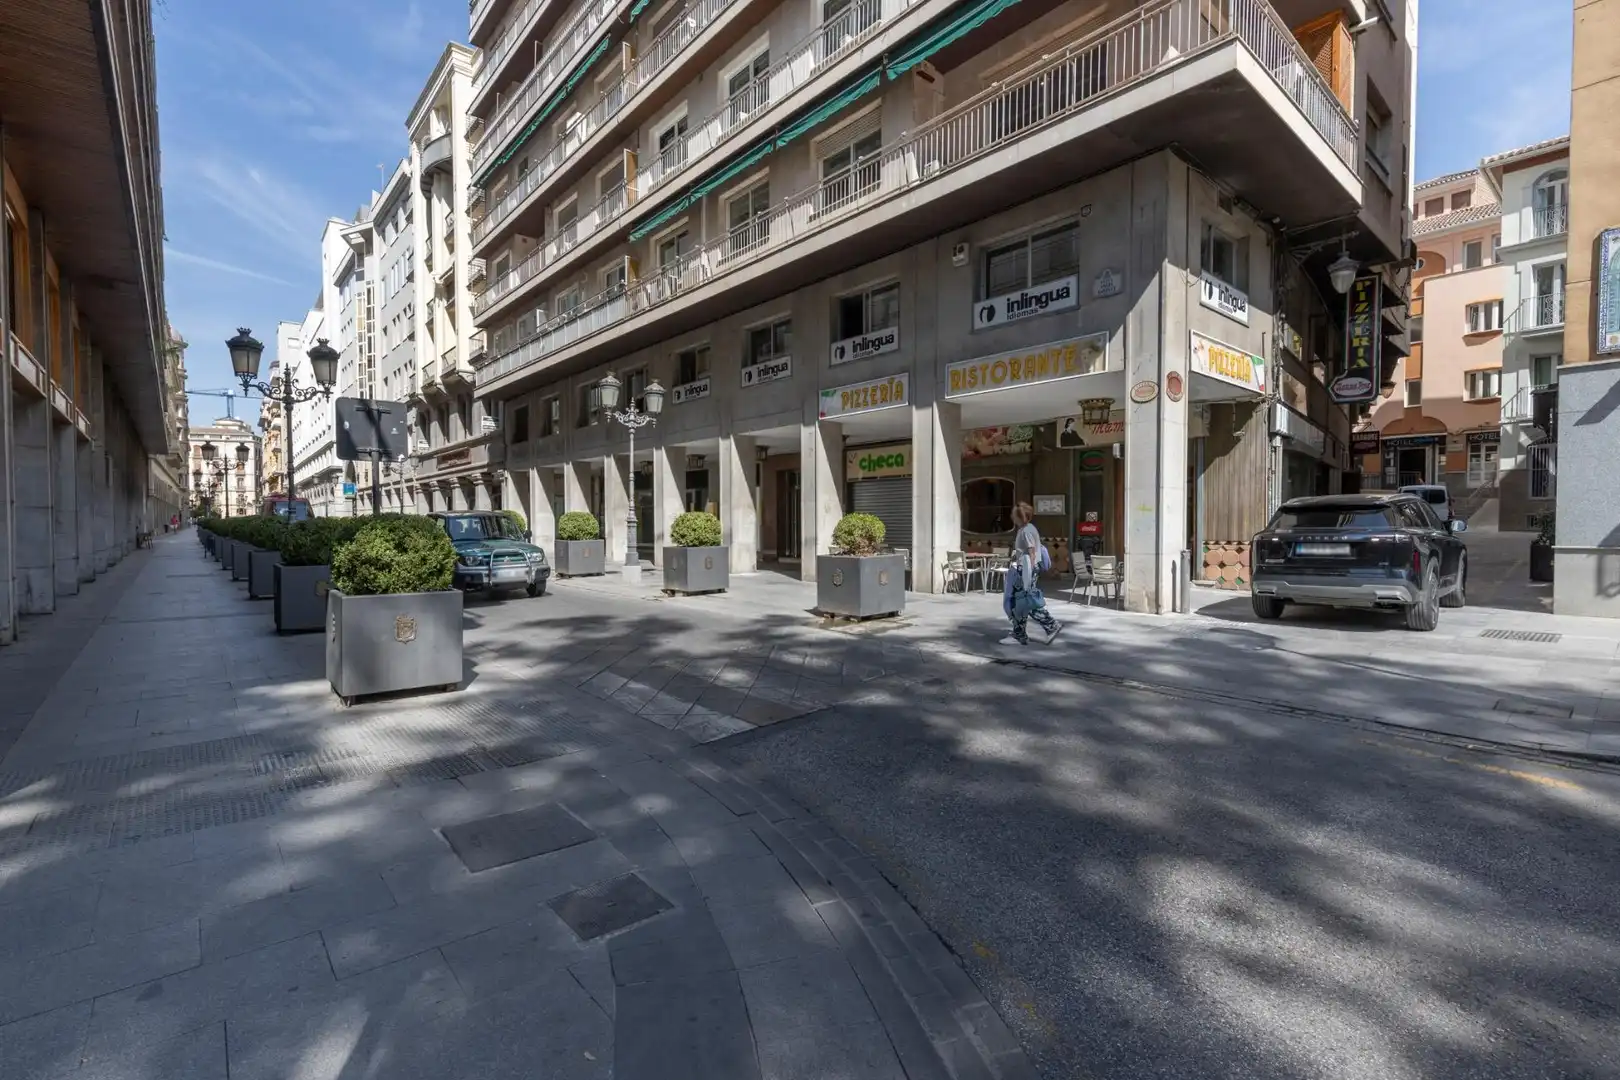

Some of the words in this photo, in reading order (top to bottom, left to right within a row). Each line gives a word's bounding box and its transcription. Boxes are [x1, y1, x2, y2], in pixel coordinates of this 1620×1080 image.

[1006, 284, 1071, 314] inlingua
[1218, 284, 1247, 313] inlingua
[1351, 280, 1371, 368] PIZZERIA
[852, 333, 895, 353] inlingua
[757, 361, 789, 378] inlingua
[950, 343, 1078, 391] RISTORANTE
[684, 383, 708, 397] inlingua
[858, 453, 904, 472] checa
